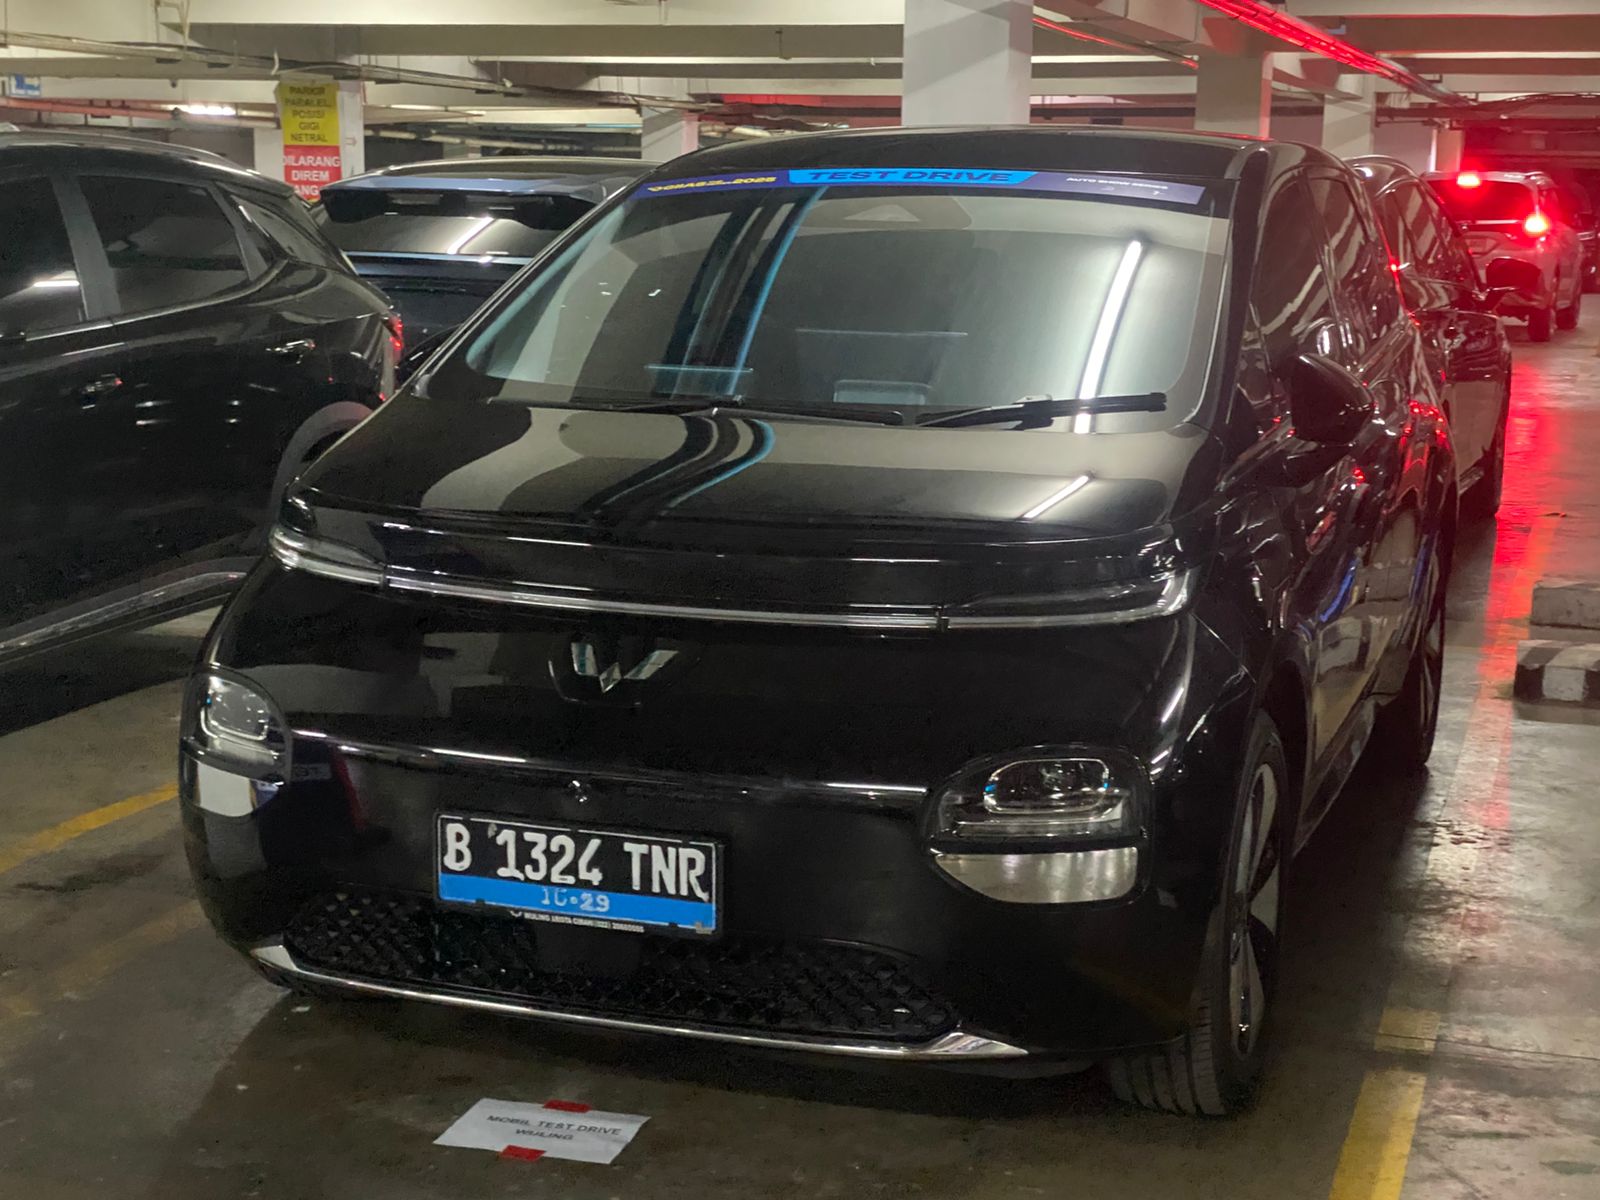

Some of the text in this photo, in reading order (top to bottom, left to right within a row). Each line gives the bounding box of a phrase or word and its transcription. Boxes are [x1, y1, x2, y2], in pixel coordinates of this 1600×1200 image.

[282, 155, 341, 167] DILARANG
[291, 170, 330, 181] DIREM
[732, 176, 777, 185] 2025
[808, 171, 1013, 182] TEST DRIVE
[293, 184, 320, 195] ANG
[443, 822, 710, 902] B 1324 TNR
[486, 1114, 622, 1136] MOBIL TEST DRIVE
[515, 1128, 573, 1141] WULING
